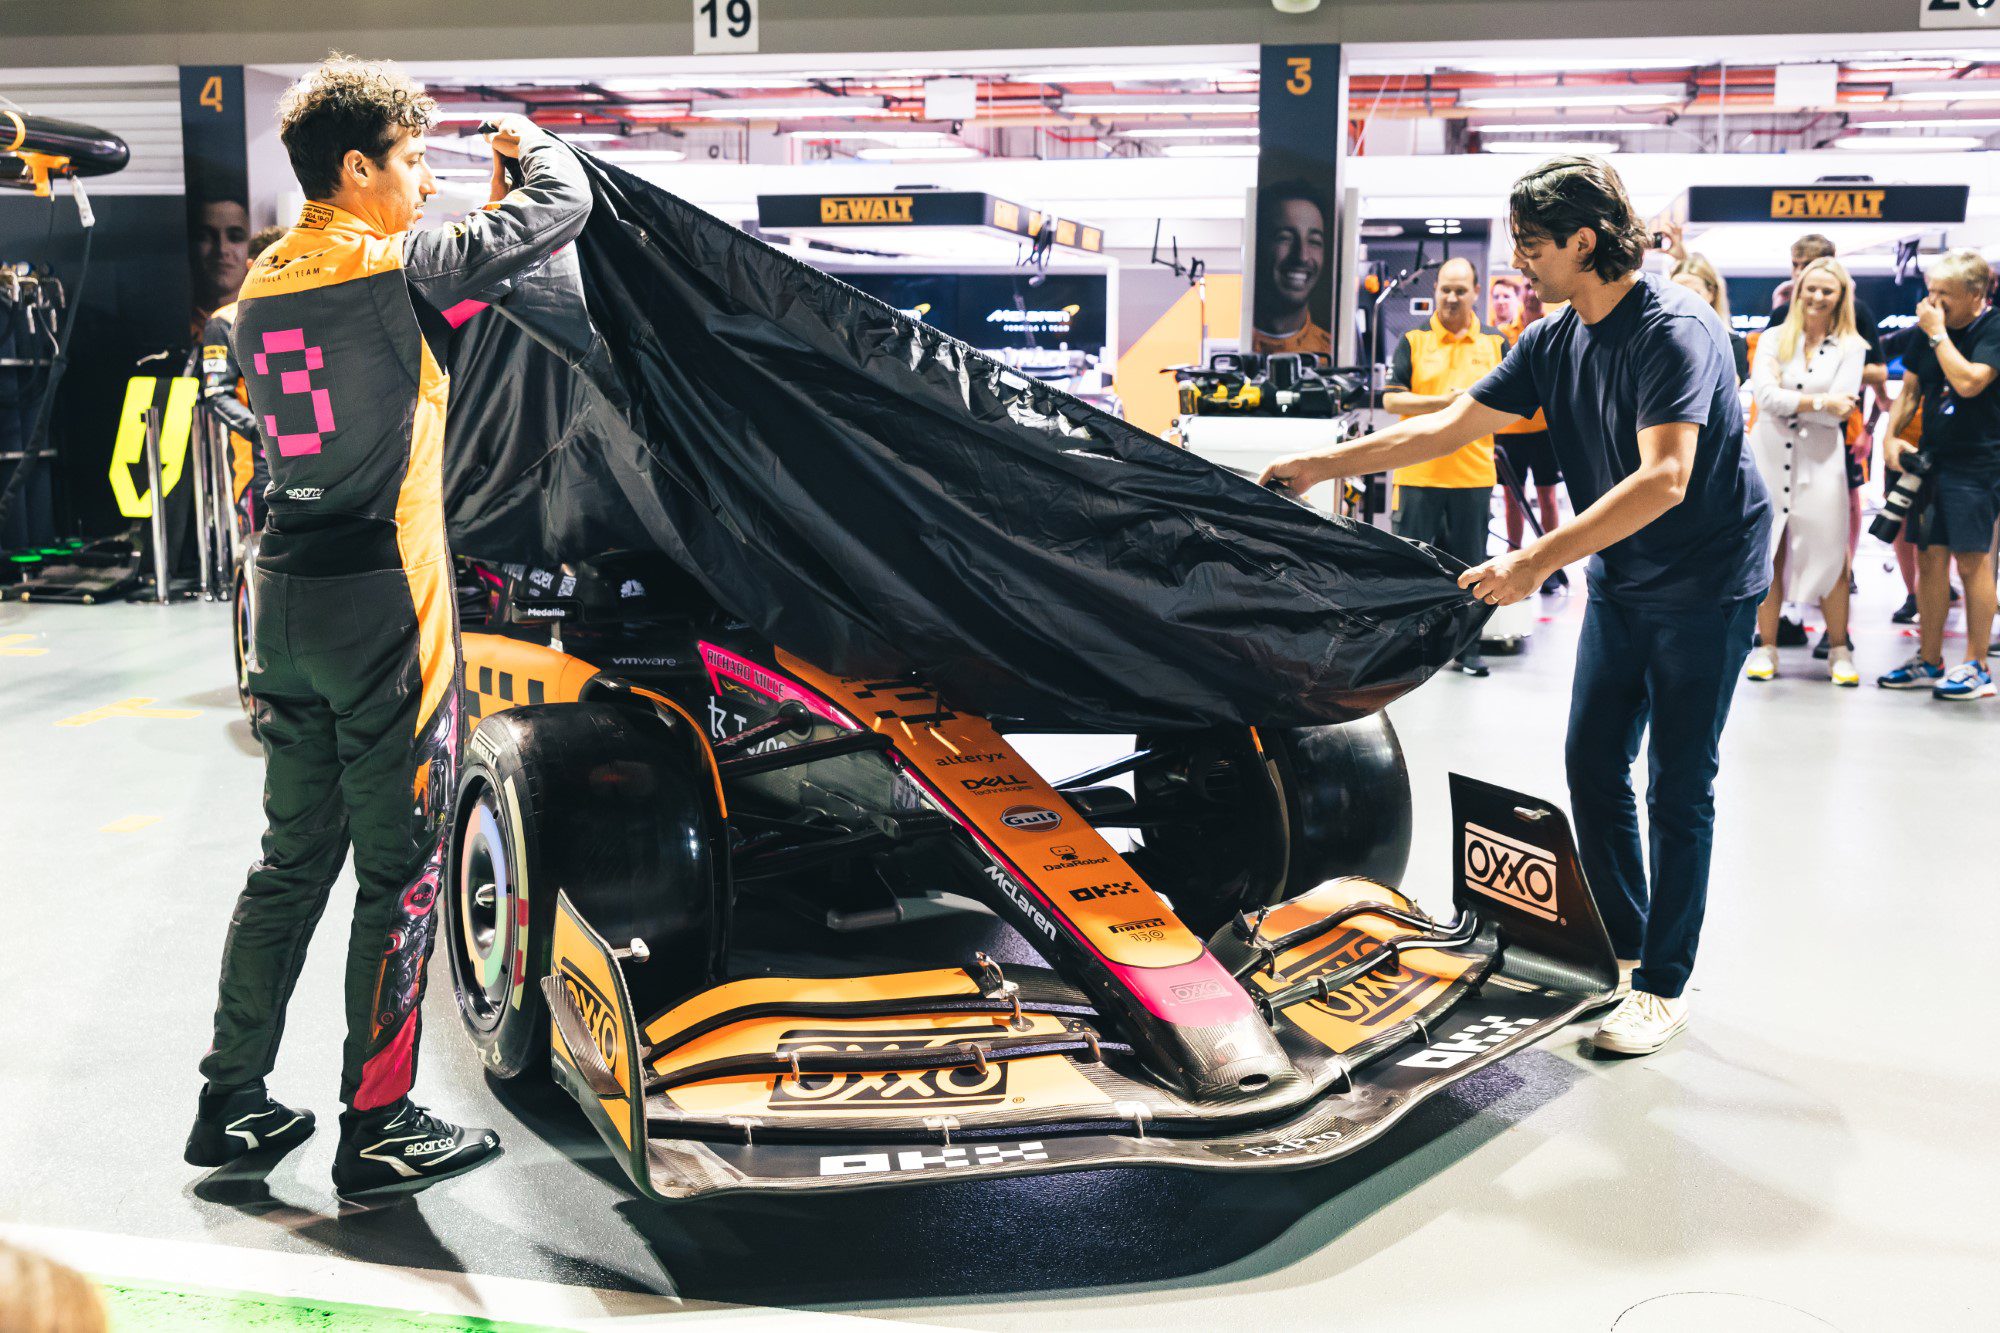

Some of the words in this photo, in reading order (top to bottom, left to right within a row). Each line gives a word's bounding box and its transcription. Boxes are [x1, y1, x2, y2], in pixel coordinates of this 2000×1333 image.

[701, 0, 751, 37] 19
[1286, 57, 1312, 95] 3
[200, 76, 222, 112] 4
[253, 328, 336, 457] 3
[527, 607, 566, 617] Medallia
[612, 656, 677, 667] vmware
[707, 649, 751, 681] RICHARD
[753, 670, 785, 699] MILLE
[936, 752, 1007, 767] alteryx
[1003, 811, 1060, 826] Gulf
[1042, 856, 1110, 872] DataRobot
[1467, 839, 1553, 903] OXXO
[983, 865, 1057, 942] McLaren
[1068, 881, 1140, 902] OKX
[1107, 917, 1166, 934] PIRELLI
[1395, 1015, 1540, 1069] OKX
[403, 1136, 456, 1157] sparco
[819, 1140, 1049, 1176] OKX
[1240, 1128, 1343, 1158] FxPro
